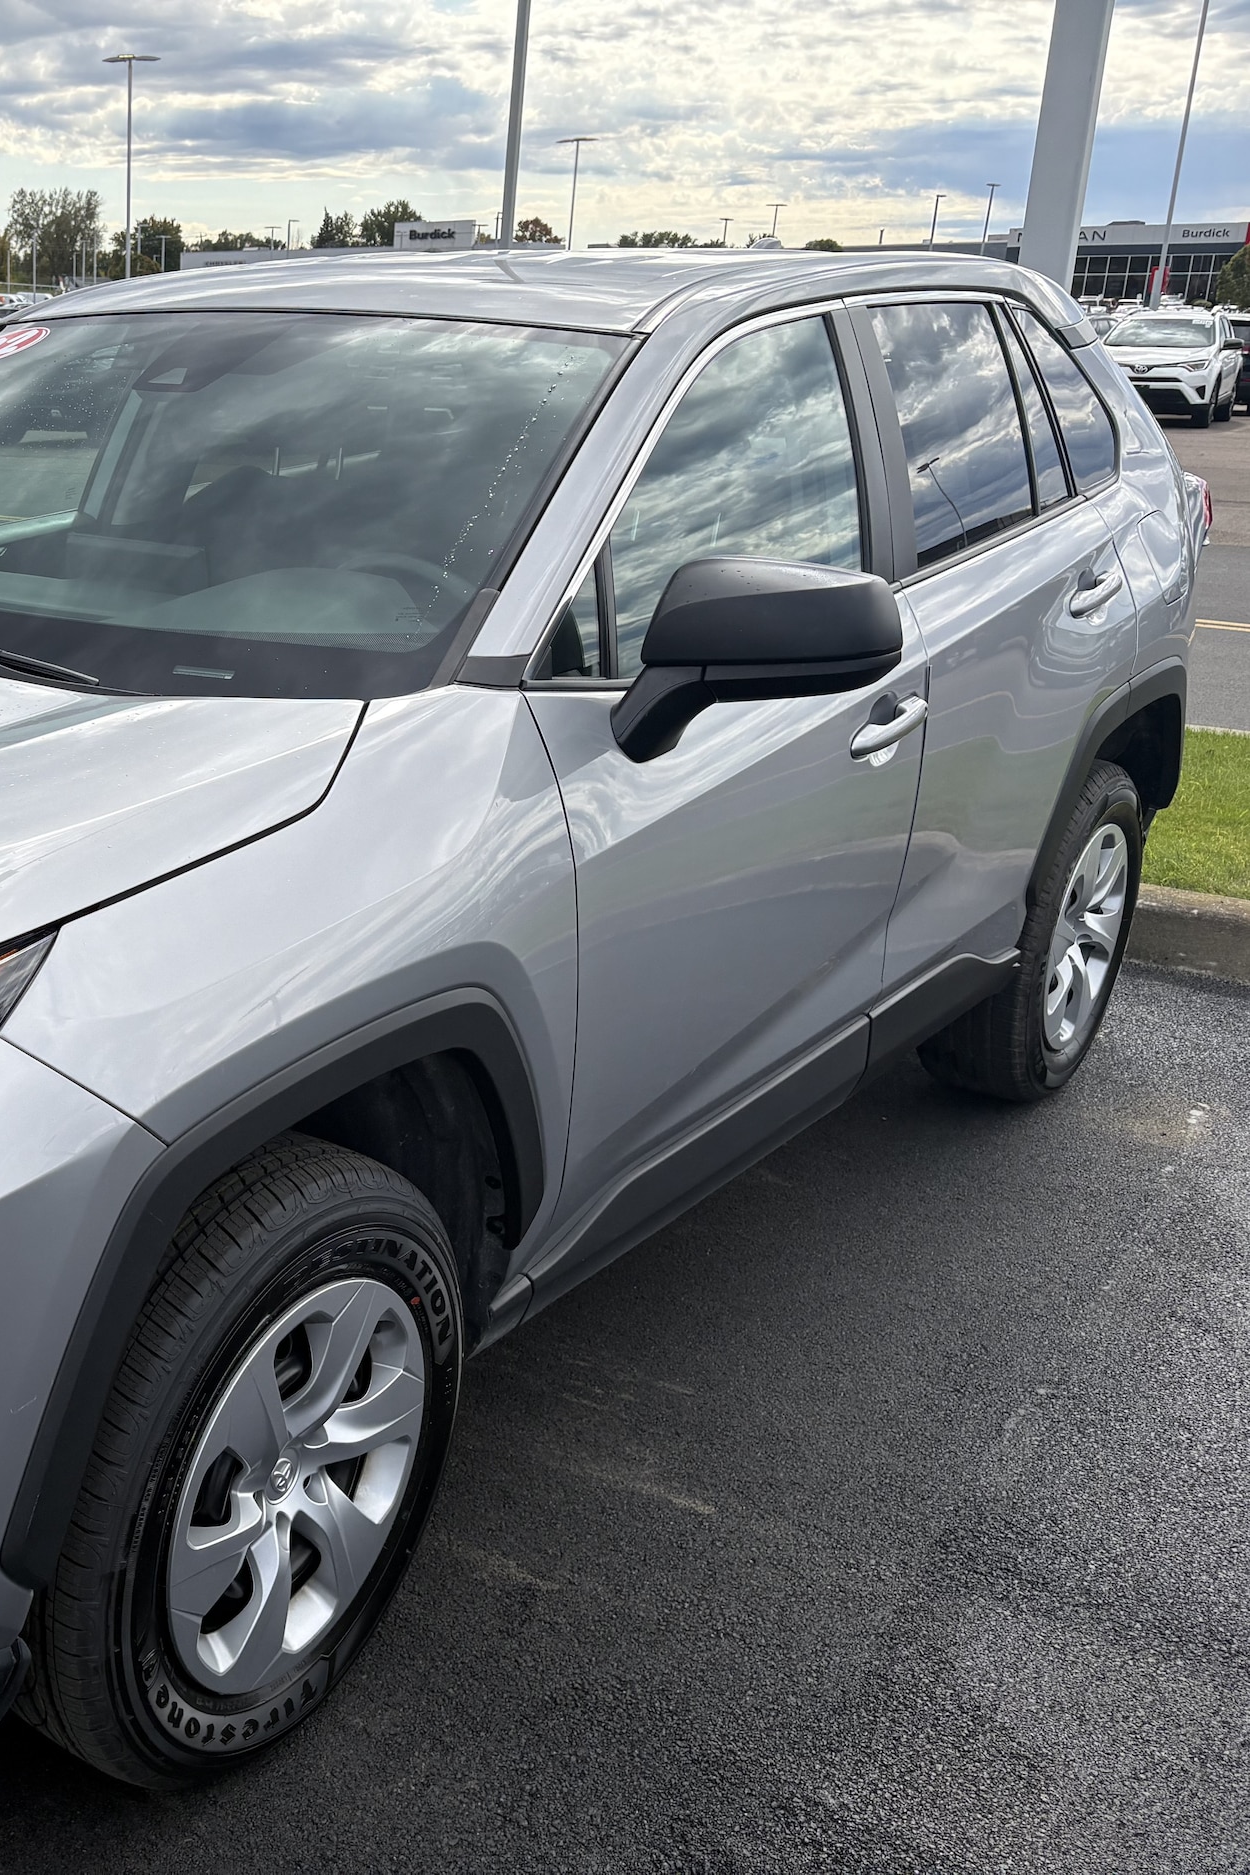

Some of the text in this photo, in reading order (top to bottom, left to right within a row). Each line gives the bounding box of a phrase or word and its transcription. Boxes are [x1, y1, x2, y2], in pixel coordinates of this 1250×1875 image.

[409, 228, 456, 240] Burdick
[1182, 228, 1230, 238] Burdick
[283, 1236, 453, 1347] DESTINATION
[154, 1678, 319, 1747] Firestone
